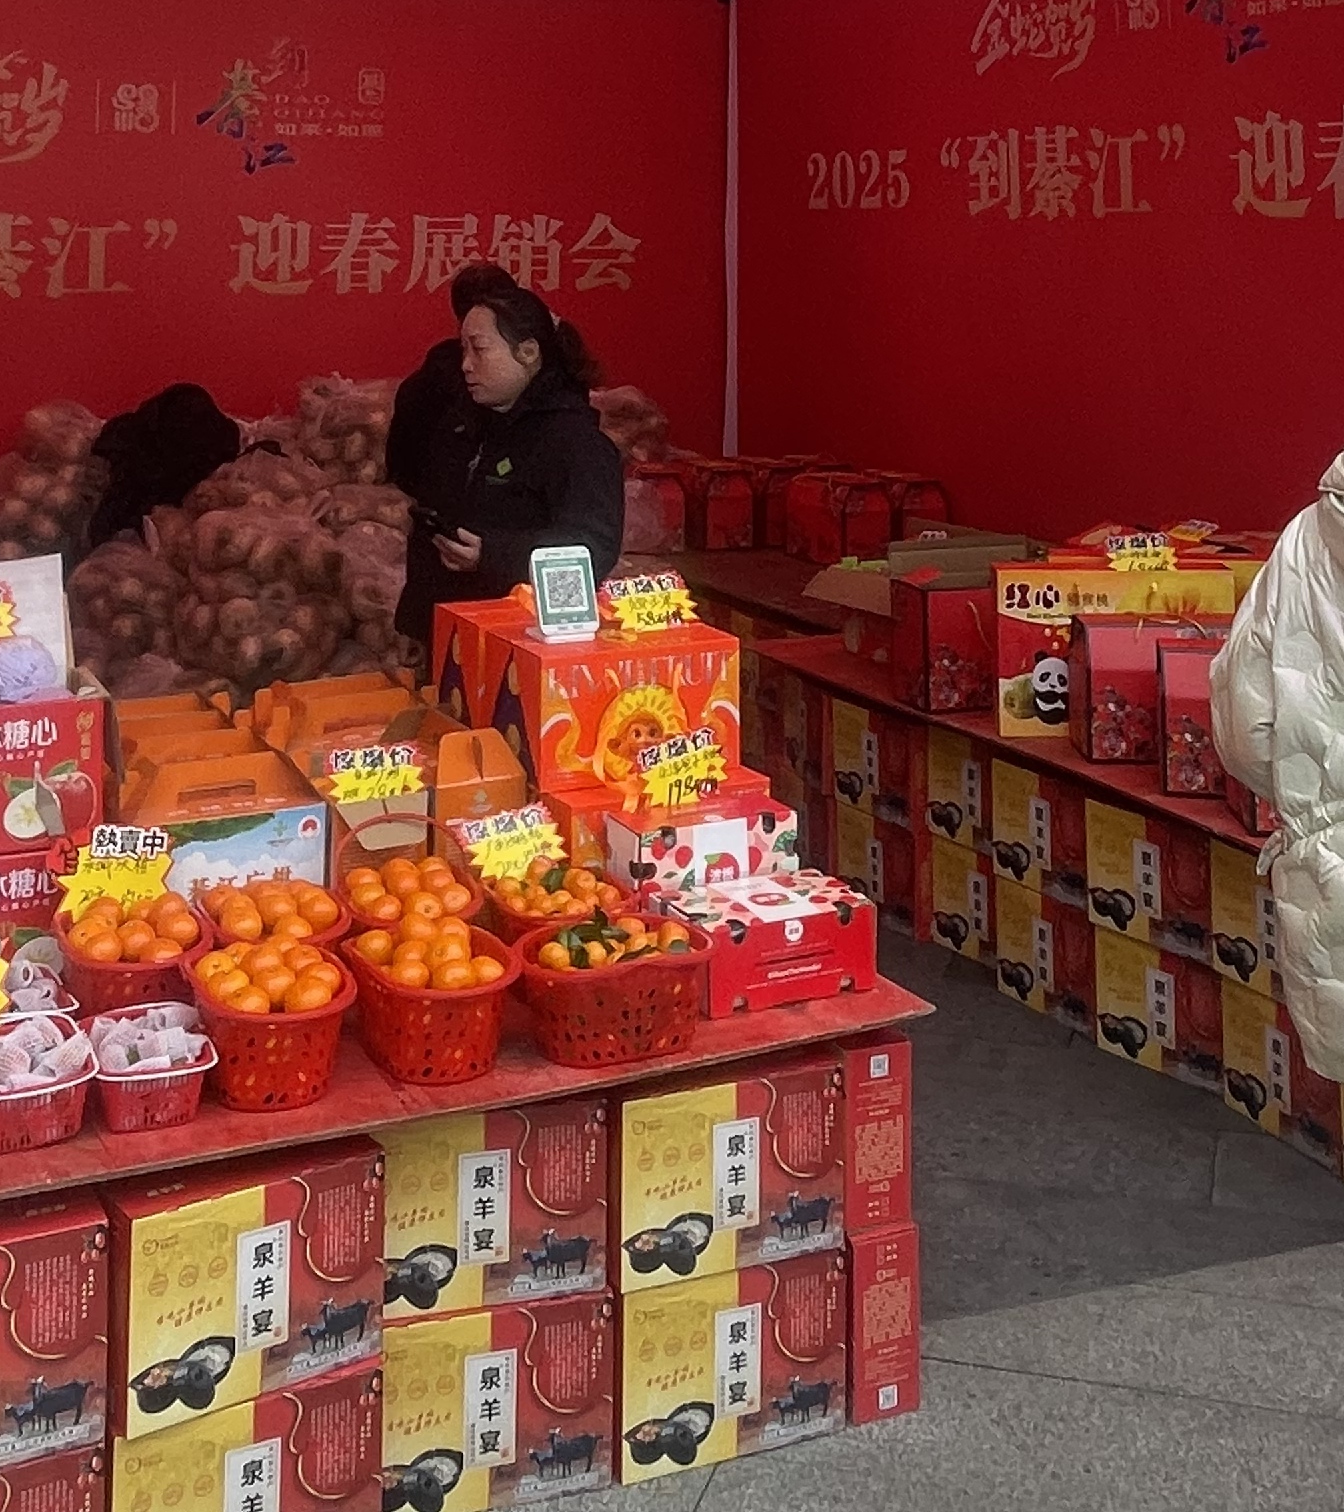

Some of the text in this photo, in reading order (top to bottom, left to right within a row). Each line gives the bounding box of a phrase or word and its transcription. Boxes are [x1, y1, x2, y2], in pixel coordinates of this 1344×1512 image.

[807, 149, 911, 211] 2025
[938, 125, 1186, 221] “到綦江”
[228, 211, 642, 296] 迎春展销会
[472, 1166, 496, 1252] 泉羊宴
[726, 1134, 748, 1217] 泉羊宴
[252, 1242, 276, 1337] 泉羊宴
[728, 1321, 749, 1405] 泉羊宴
[478, 1365, 503, 1454] 泉羊宴
